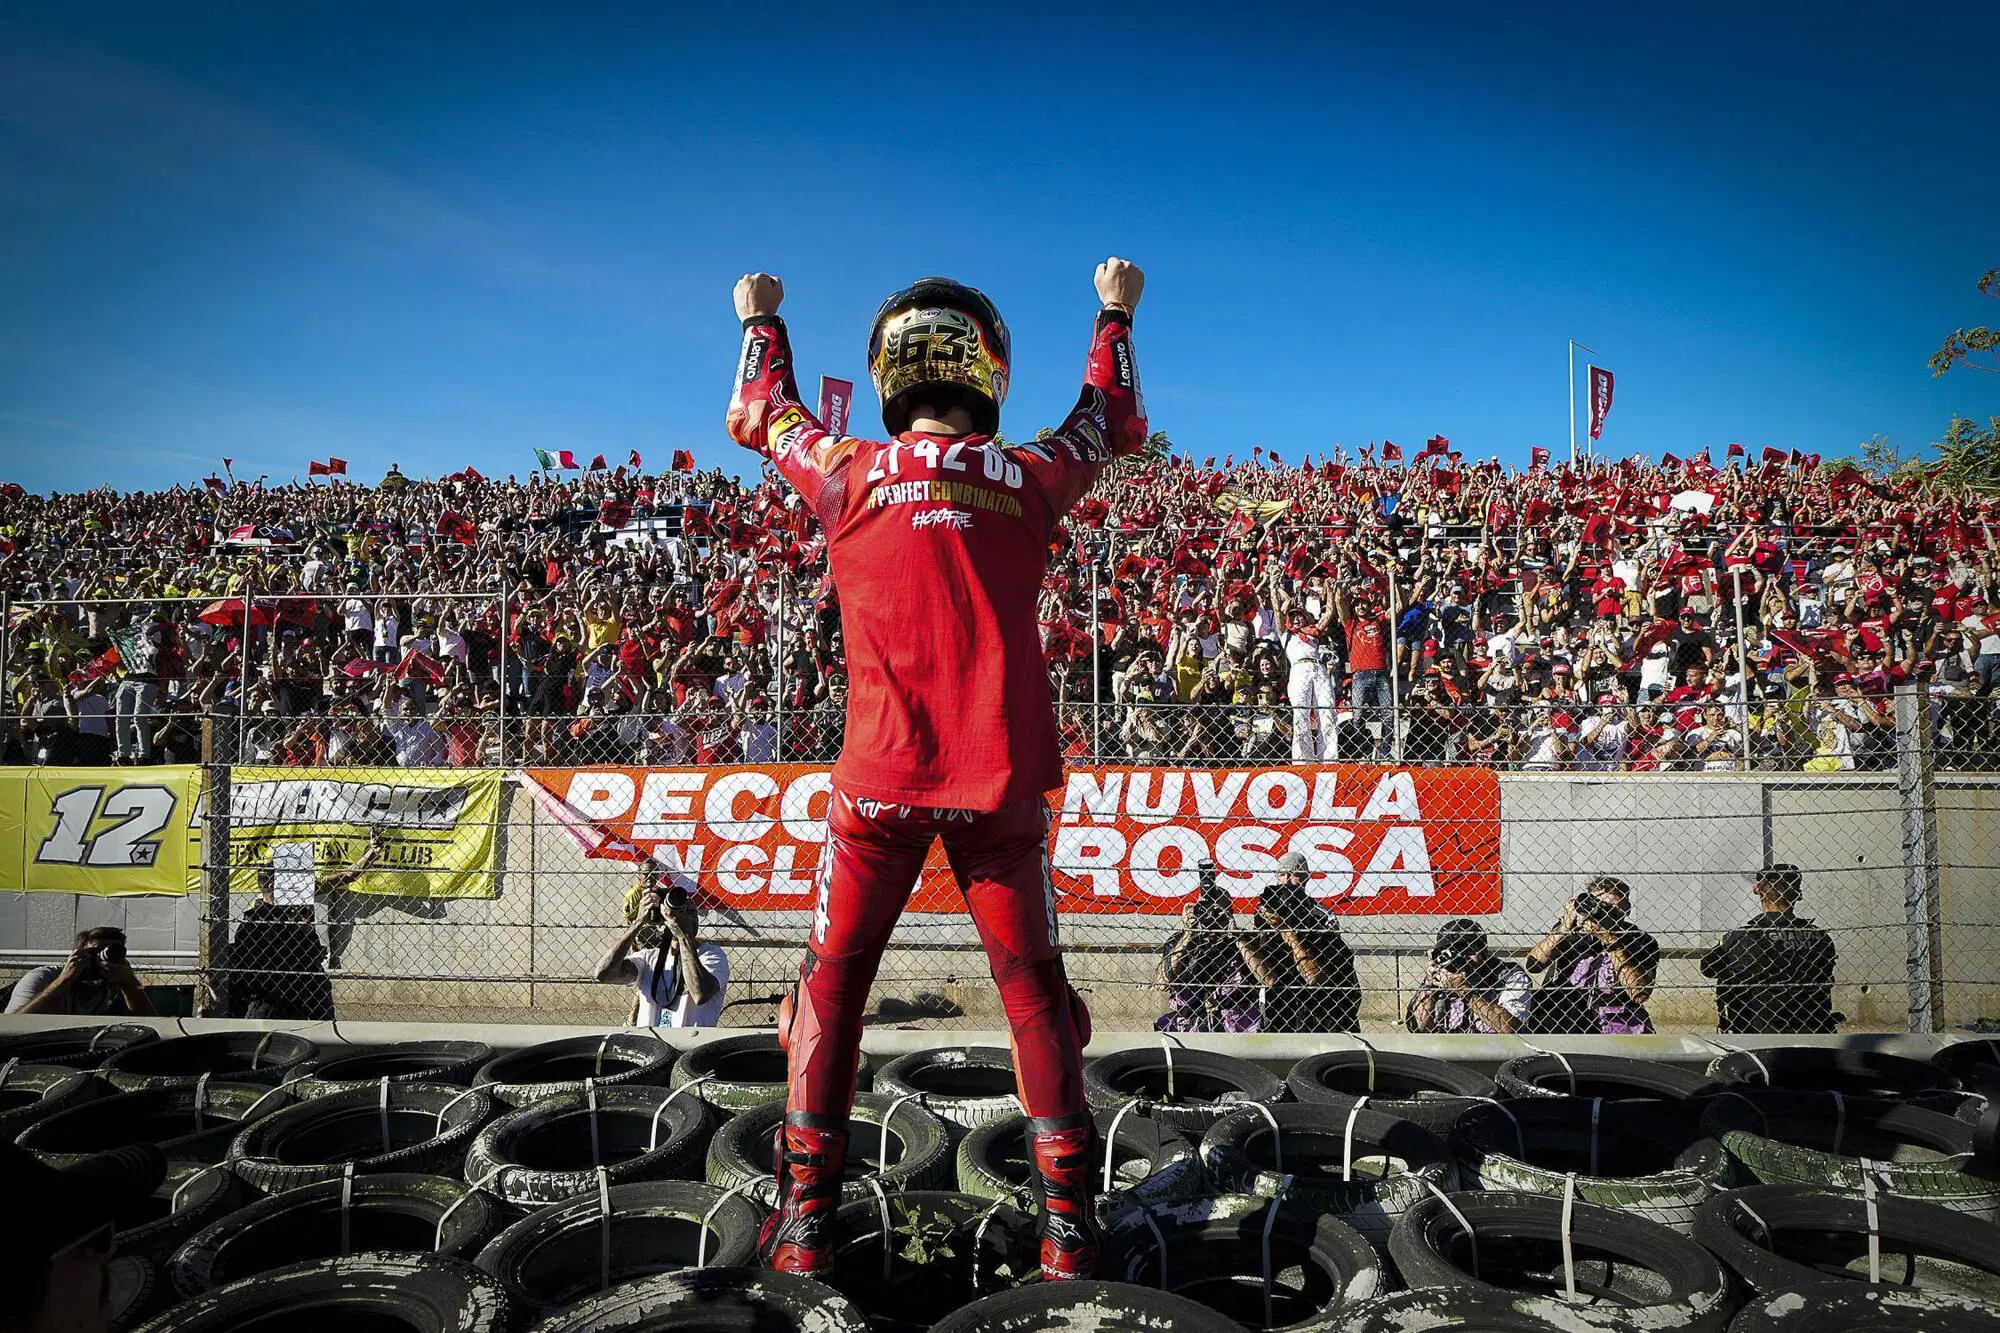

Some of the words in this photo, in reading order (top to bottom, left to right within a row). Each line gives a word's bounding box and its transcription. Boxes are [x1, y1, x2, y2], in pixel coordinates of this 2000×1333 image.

[746, 339, 766, 379] Lenovo
[898, 322, 970, 370] 63
[1116, 342, 1131, 388] Lenovo
[829, 393, 843, 436] DUCA
[564, 771, 833, 843] PECC
[1060, 771, 1422, 824] NUVOLA
[35, 784, 177, 867] 12
[1050, 824, 1436, 900] ROSSA
